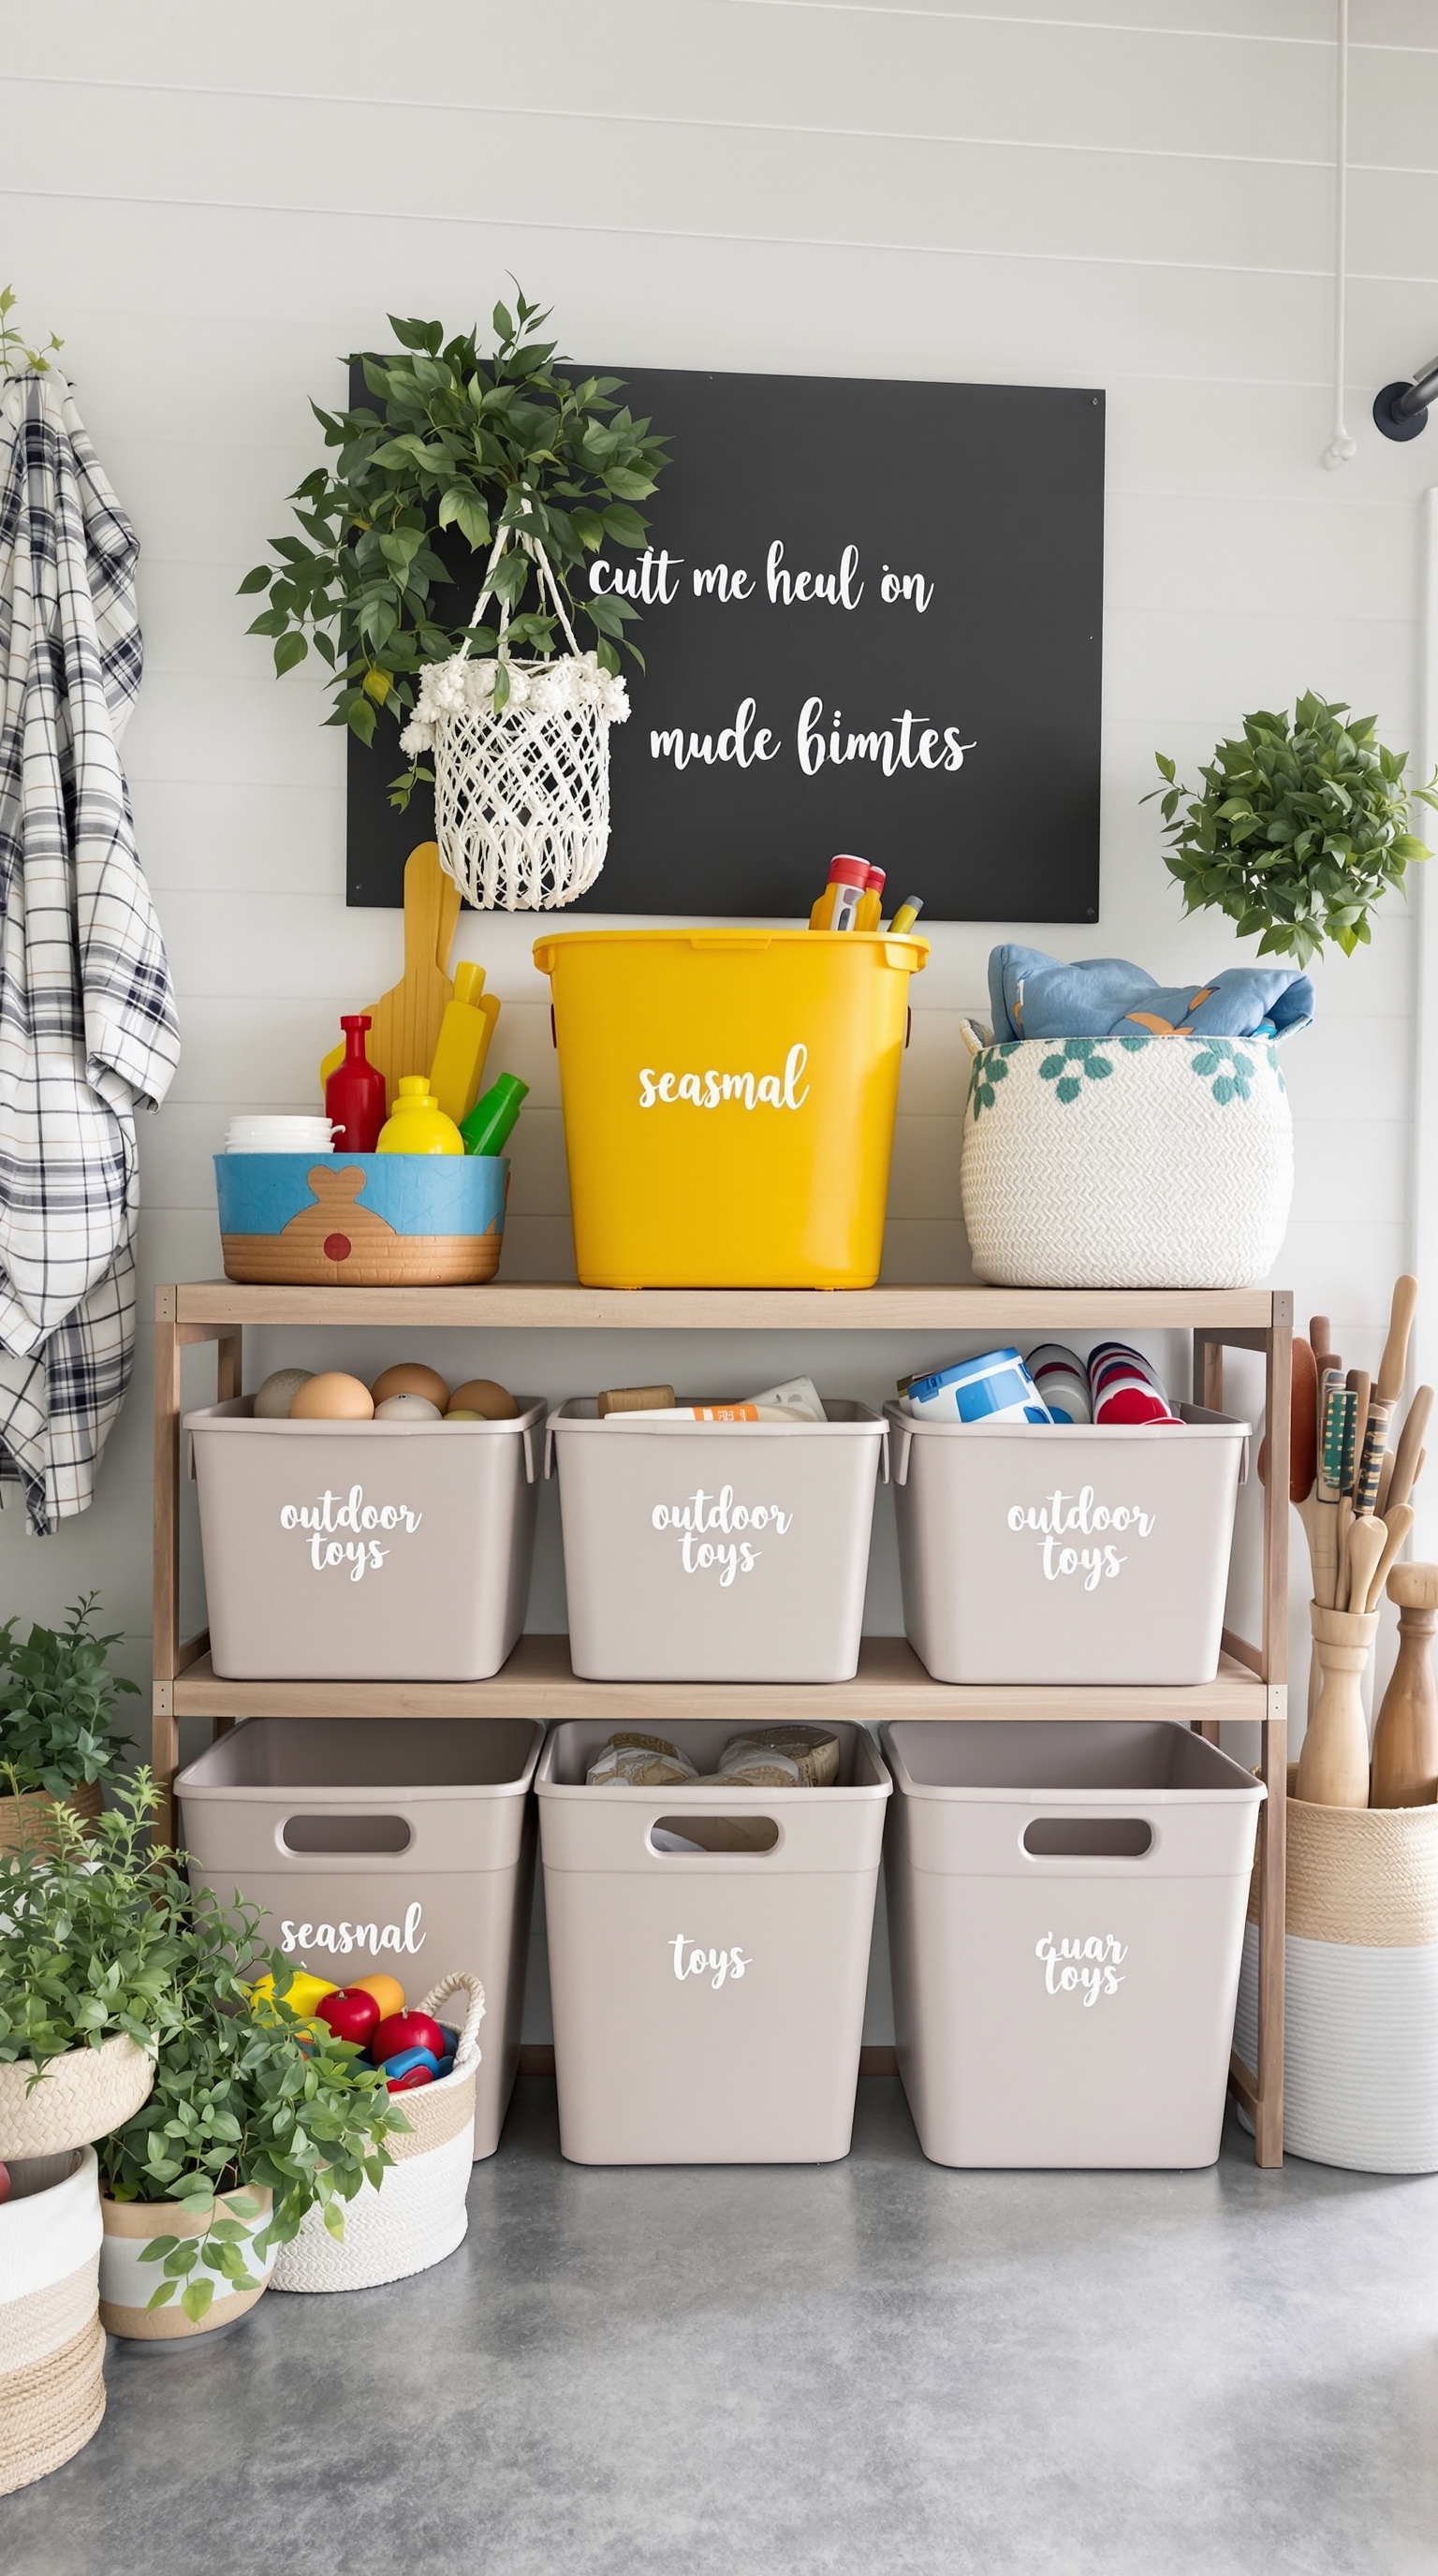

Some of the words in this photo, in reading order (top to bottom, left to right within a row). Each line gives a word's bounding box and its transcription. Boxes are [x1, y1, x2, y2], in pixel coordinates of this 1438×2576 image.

[693, 564, 756, 603] me
[650, 696, 782, 770] mude
[280, 1485, 422, 1533] outdoor
[652, 1485, 794, 1535] outdoor
[1007, 1485, 1156, 1538] outdoor
[305, 1532, 391, 1582] toys
[678, 1531, 763, 1588] toys
[1036, 1534, 1128, 1591] toys
[281, 1901, 427, 1955] seasnal
[668, 1933, 753, 1990] toys
[1039, 1948, 1126, 2008] toys
